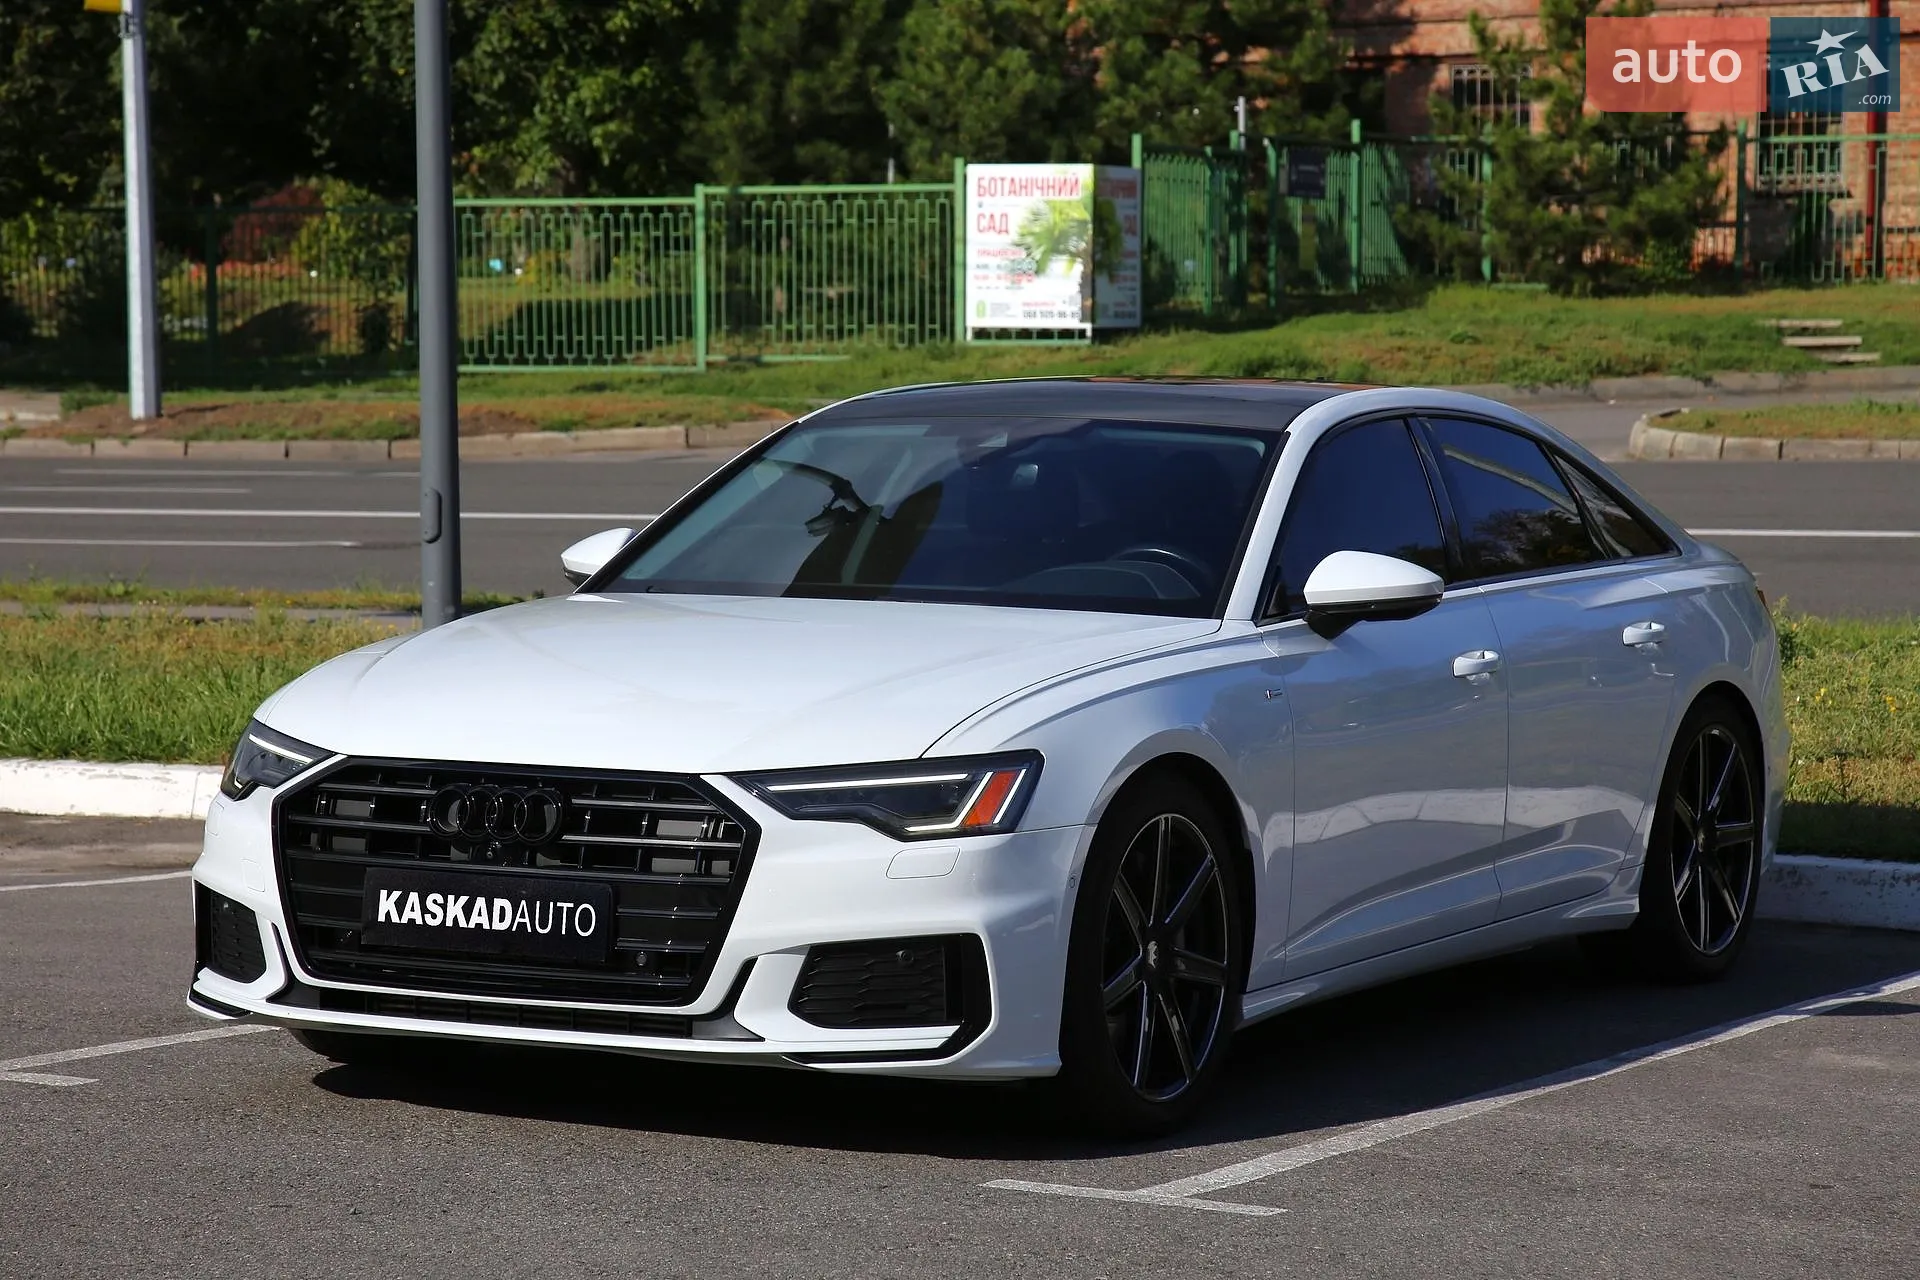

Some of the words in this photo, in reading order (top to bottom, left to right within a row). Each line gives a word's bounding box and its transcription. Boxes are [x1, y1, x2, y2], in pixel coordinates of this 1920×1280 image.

[977, 173, 1080, 197] БОТАНІЧНИЙ
[977, 213, 1009, 235] САД
[377, 889, 596, 937] KASKADAUTO
